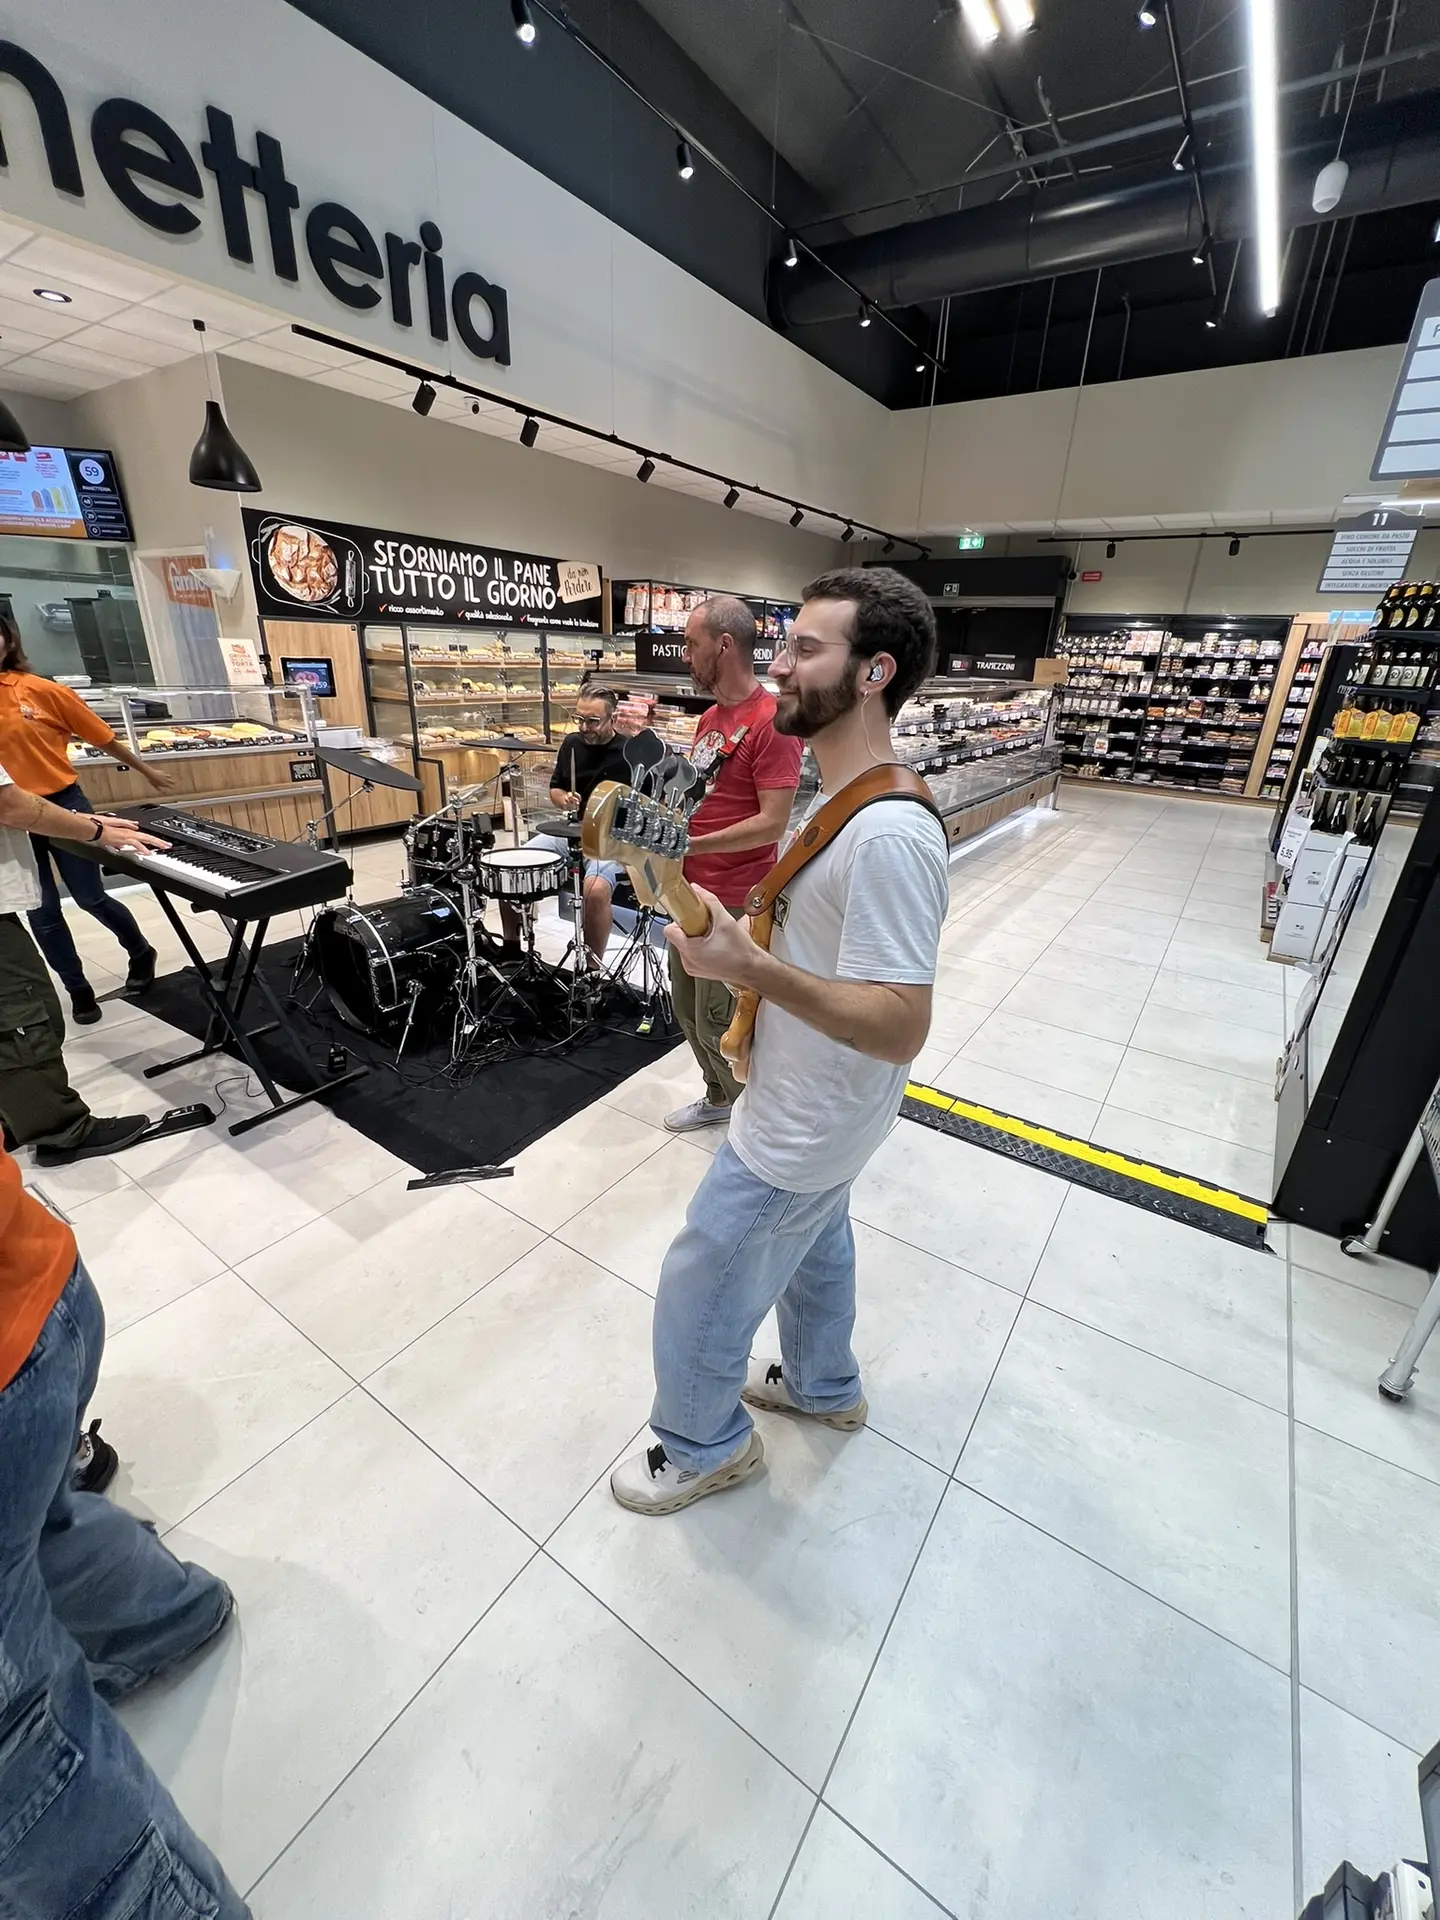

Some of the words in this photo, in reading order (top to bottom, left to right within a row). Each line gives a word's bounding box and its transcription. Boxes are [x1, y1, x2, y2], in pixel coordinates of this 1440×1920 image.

[0, 40, 511, 367] netteria
[85, 466, 99, 476] 59
[1372, 512, 1389, 527] 11
[373, 539, 488, 577] SFORNIAMO
[494, 556, 508, 581] IL
[513, 560, 551, 587] PANE
[368, 564, 456, 600] TUTTO
[463, 575, 481, 603] IL
[487, 579, 557, 610] GIORNO
[388, 604, 404, 613] ricco
[404, 605, 445, 616] assortimento
[464, 609, 485, 621] qualità
[485, 610, 513, 622] selezionata
[549, 618, 562, 626] come
[976, 661, 1016, 671] TRAMEZZINI
